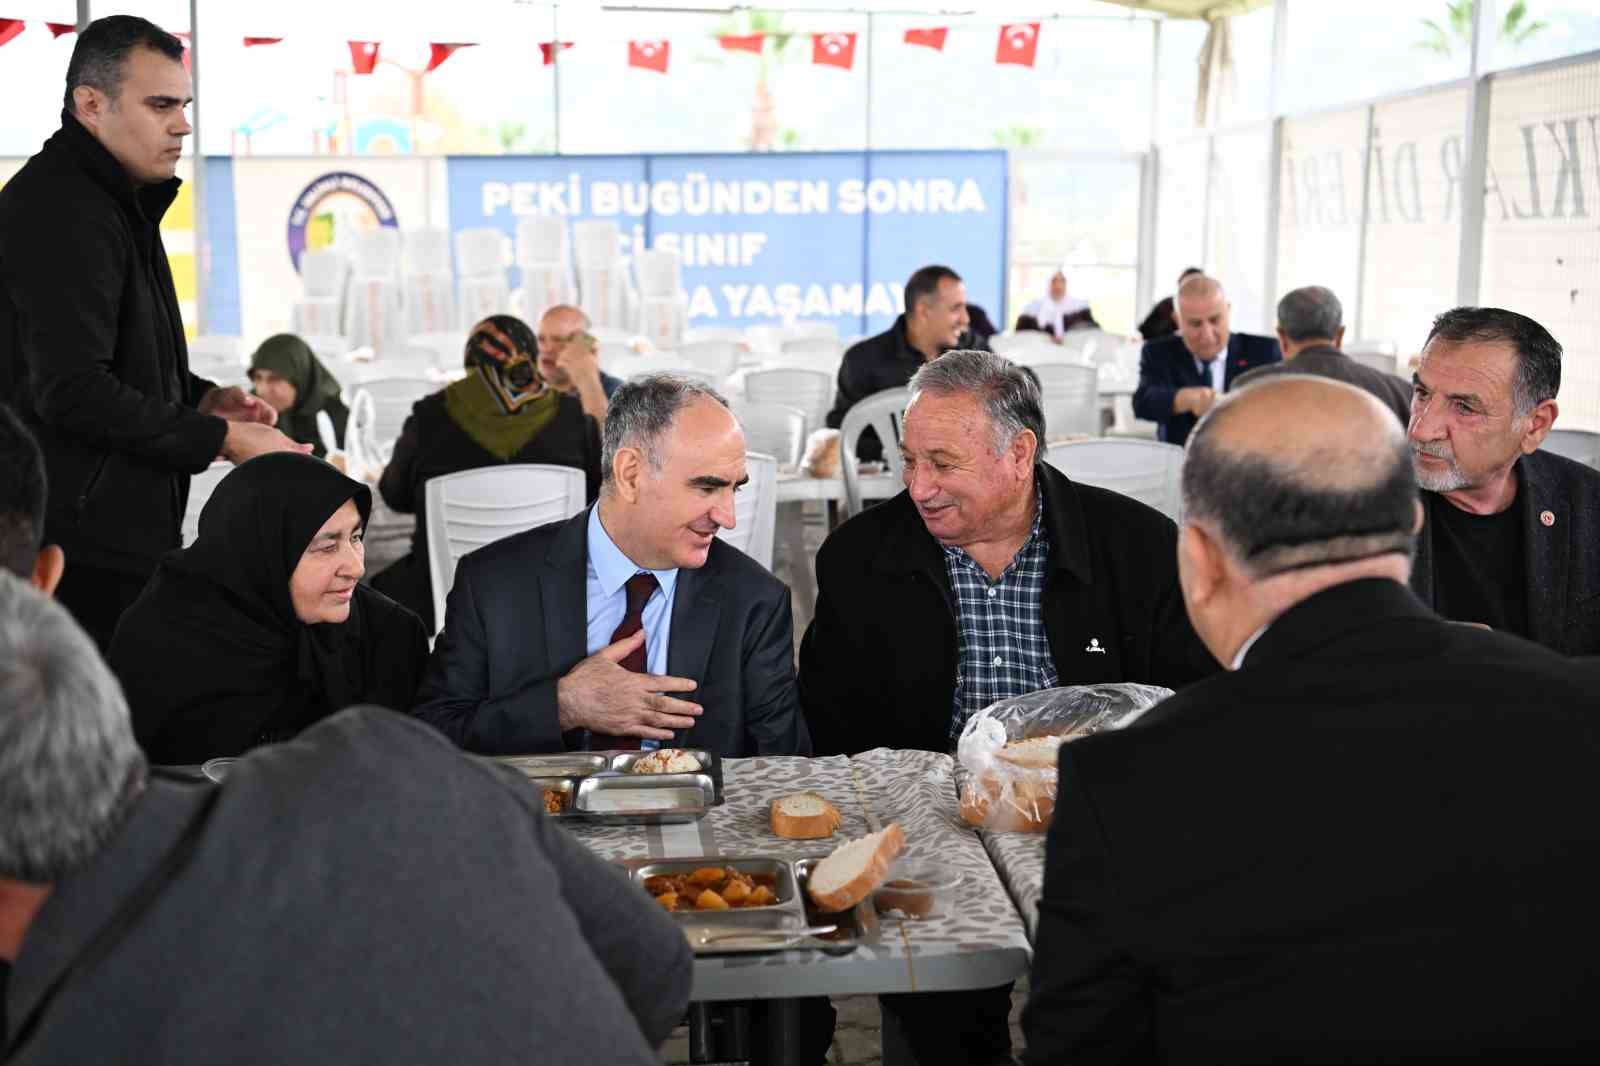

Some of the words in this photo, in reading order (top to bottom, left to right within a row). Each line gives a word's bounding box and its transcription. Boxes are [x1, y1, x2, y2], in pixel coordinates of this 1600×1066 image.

[481, 172, 581, 216] PEKİ
[590, 171, 829, 216] BUGÜNDEN
[837, 178, 986, 215] SONRA
